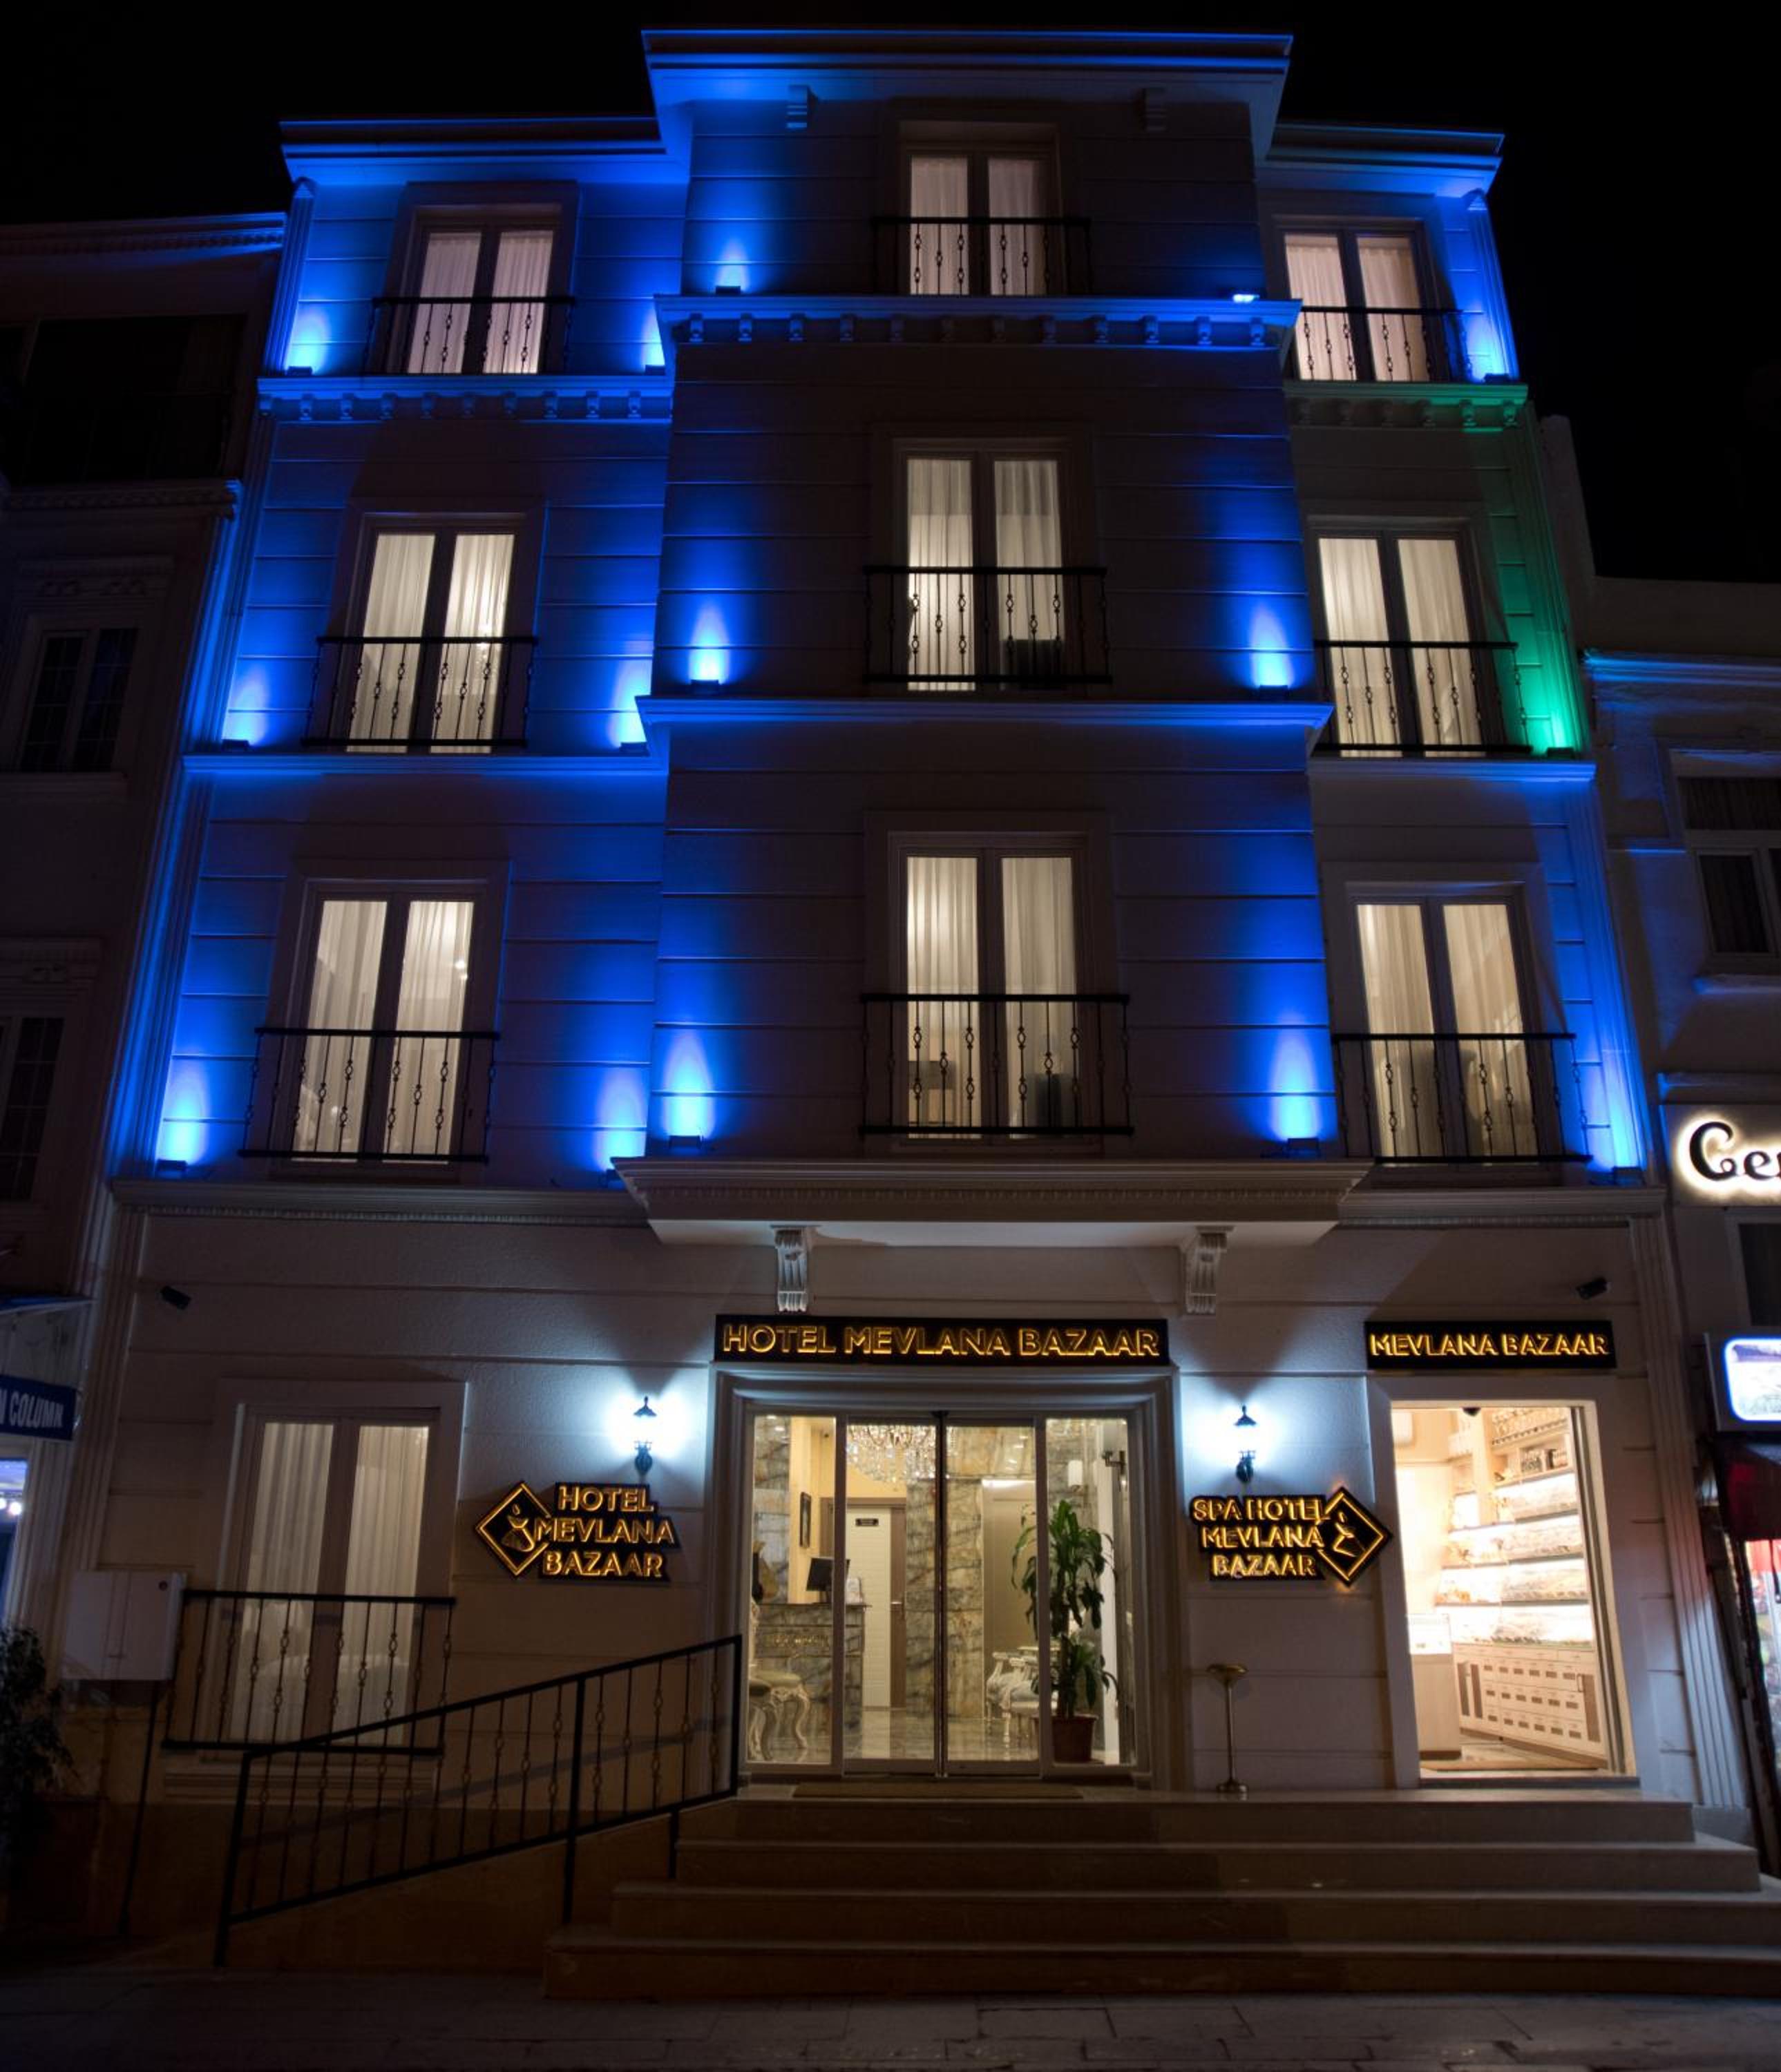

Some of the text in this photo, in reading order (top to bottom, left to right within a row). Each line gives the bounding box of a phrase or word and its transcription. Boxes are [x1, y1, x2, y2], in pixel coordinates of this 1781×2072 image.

[723, 1324, 1160, 1356] HOTEL MEVLANA BAZAAR
[1369, 1332, 1610, 1356] MEVLANA BAZAAR
[9, 1390, 64, 1429] COLUMN
[558, 1485, 655, 1513] HOTEL
[1192, 1499, 1331, 1522] SPA HOTEL
[533, 1517, 676, 1544] MEVLANA
[1201, 1524, 1326, 1548] MEVLANA
[542, 1551, 663, 1577] BAZAAR
[1212, 1554, 1317, 1577] BAZAAR
